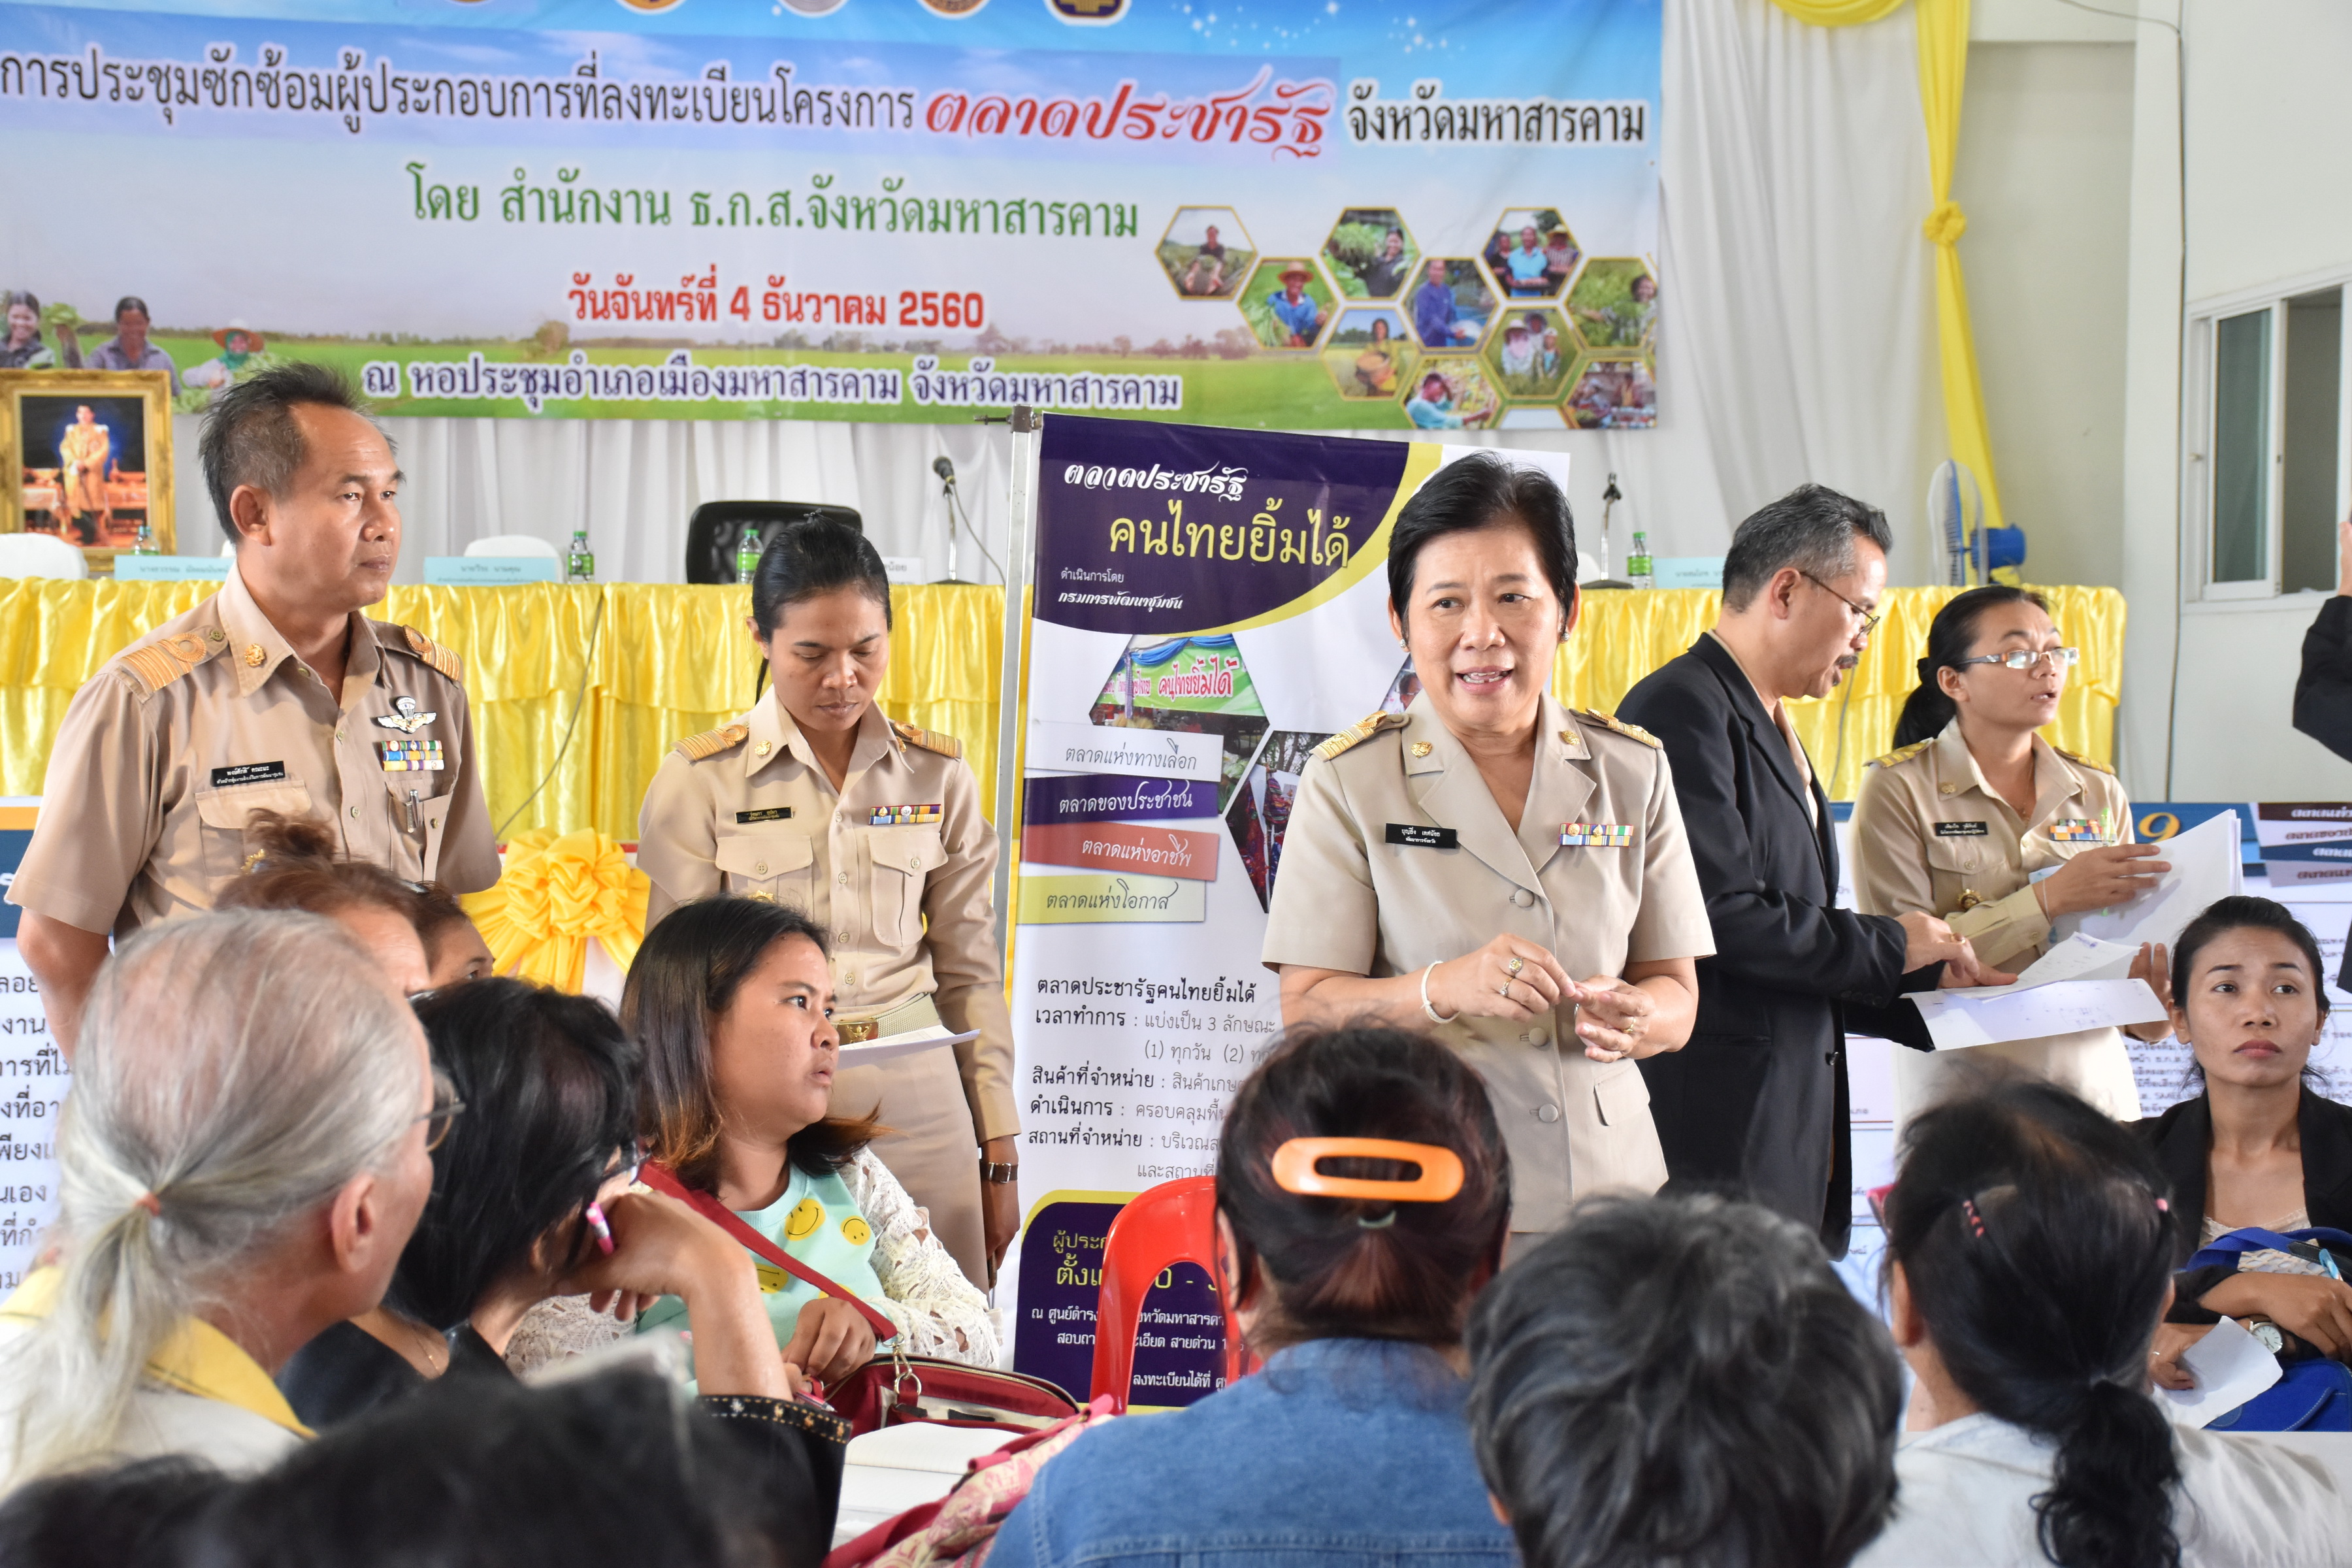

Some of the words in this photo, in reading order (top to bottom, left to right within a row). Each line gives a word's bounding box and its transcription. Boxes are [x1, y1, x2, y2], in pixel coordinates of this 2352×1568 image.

[1, 46, 913, 133] การประชุมซักซ้อมผู้ประกอบการที่ลงทะเบียนโครงการ
[926, 65, 1333, 162] ตลาดประชารัฐ
[1347, 81, 1644, 143] จังหวัดมหาสารคาม
[406, 162, 479, 220] โดย
[502, 168, 670, 225] สำนักงาน
[568, 265, 717, 323] วันจันทร์ที่
[729, 286, 750, 321] 4
[763, 274, 887, 327] ธันวาคม
[898, 291, 985, 329] 2560
[363, 367, 395, 392] ณ
[413, 351, 899, 410] หอประชุมอำเภอเมืองมหาสารคาม
[913, 359, 1180, 406] จังหวัดมหาสารคาม
[1064, 461, 1249, 503] ตลาดประชารัฐ
[1109, 498, 1350, 568] คนไทยยิ้มได้
[1060, 568, 1124, 584] ดำเนินการโดย
[1058, 591, 1183, 613] กรมการพัฒนาชุมชน
[1066, 738, 1197, 770] ตลาดแห่งทางเลือก
[1059, 780, 1193, 814] ตลาดของประชาชน
[1082, 833, 1192, 868] ตลาดแห่งอาชีพ
[1047, 878, 1179, 910] ตลาดแห่งโอกาส
[1037, 975, 1256, 1004] ตลาดประชารัฐคนไทยยิ้มได้
[1036, 1005, 1125, 1027] เวลาทำการ
[1145, 1009, 1201, 1031] แบ่งเป็น
[1207, 1017, 1216, 1031] 3
[1223, 1014, 1275, 1034] ลักษณะ
[1145, 1040, 1164, 1060] (1)
[1171, 1043, 1211, 1065] ทุกวัน
[1224, 1044, 1244, 1064] (2)
[1032, 1060, 1154, 1088] สินค้าที่จำหน่าย
[1031, 1094, 1113, 1117] ดำเนินการ
[1028, 1122, 1142, 1148] สถานที่จำหน่าย
[1032, 1308, 1043, 1319] ณ
[1171, 1335, 1215, 1349] สายด่วน
[1133, 1371, 1211, 1388] ลงทะเบียนได้ที่
